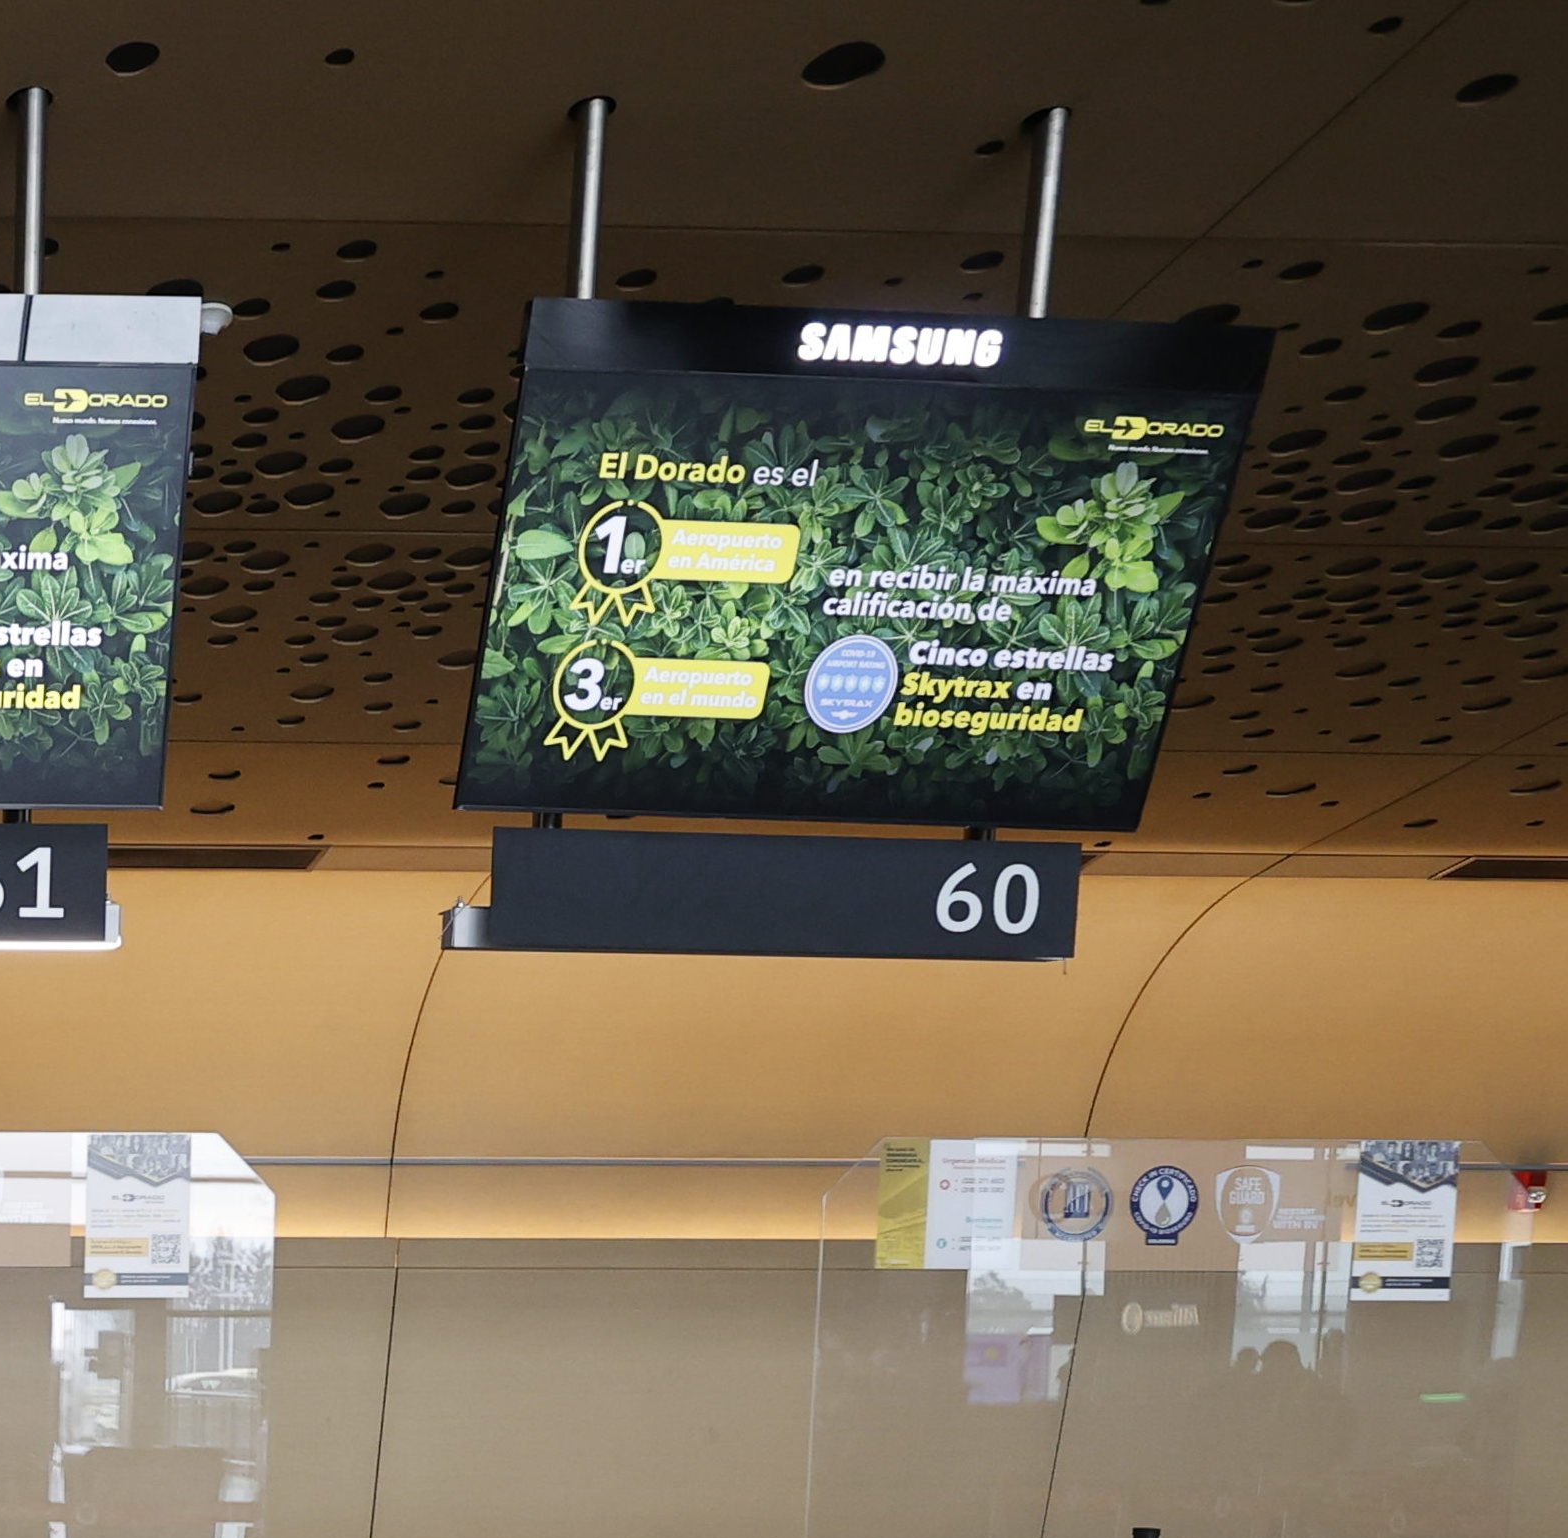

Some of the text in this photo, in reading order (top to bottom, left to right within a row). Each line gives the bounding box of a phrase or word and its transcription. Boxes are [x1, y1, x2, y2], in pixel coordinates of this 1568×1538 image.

[796, 322, 1005, 366] SAMSUNG
[599, 452, 819, 487] El Dorado es el
[671, 528, 783, 550] Aeropuerto
[668, 553, 776, 572] en América
[829, 566, 1097, 597] en recibir la máxima
[823, 593, 1013, 622] calificación de
[7, 656, 43, 677] en
[908, 641, 1115, 672] Cinco estrellas
[644, 666, 752, 688] Aeropuerto
[900, 673, 1053, 703] Skytrax en
[640, 689, 757, 708] en el mundo
[893, 704, 1084, 735] bioseguridad
[934, 862, 1042, 936] 60
